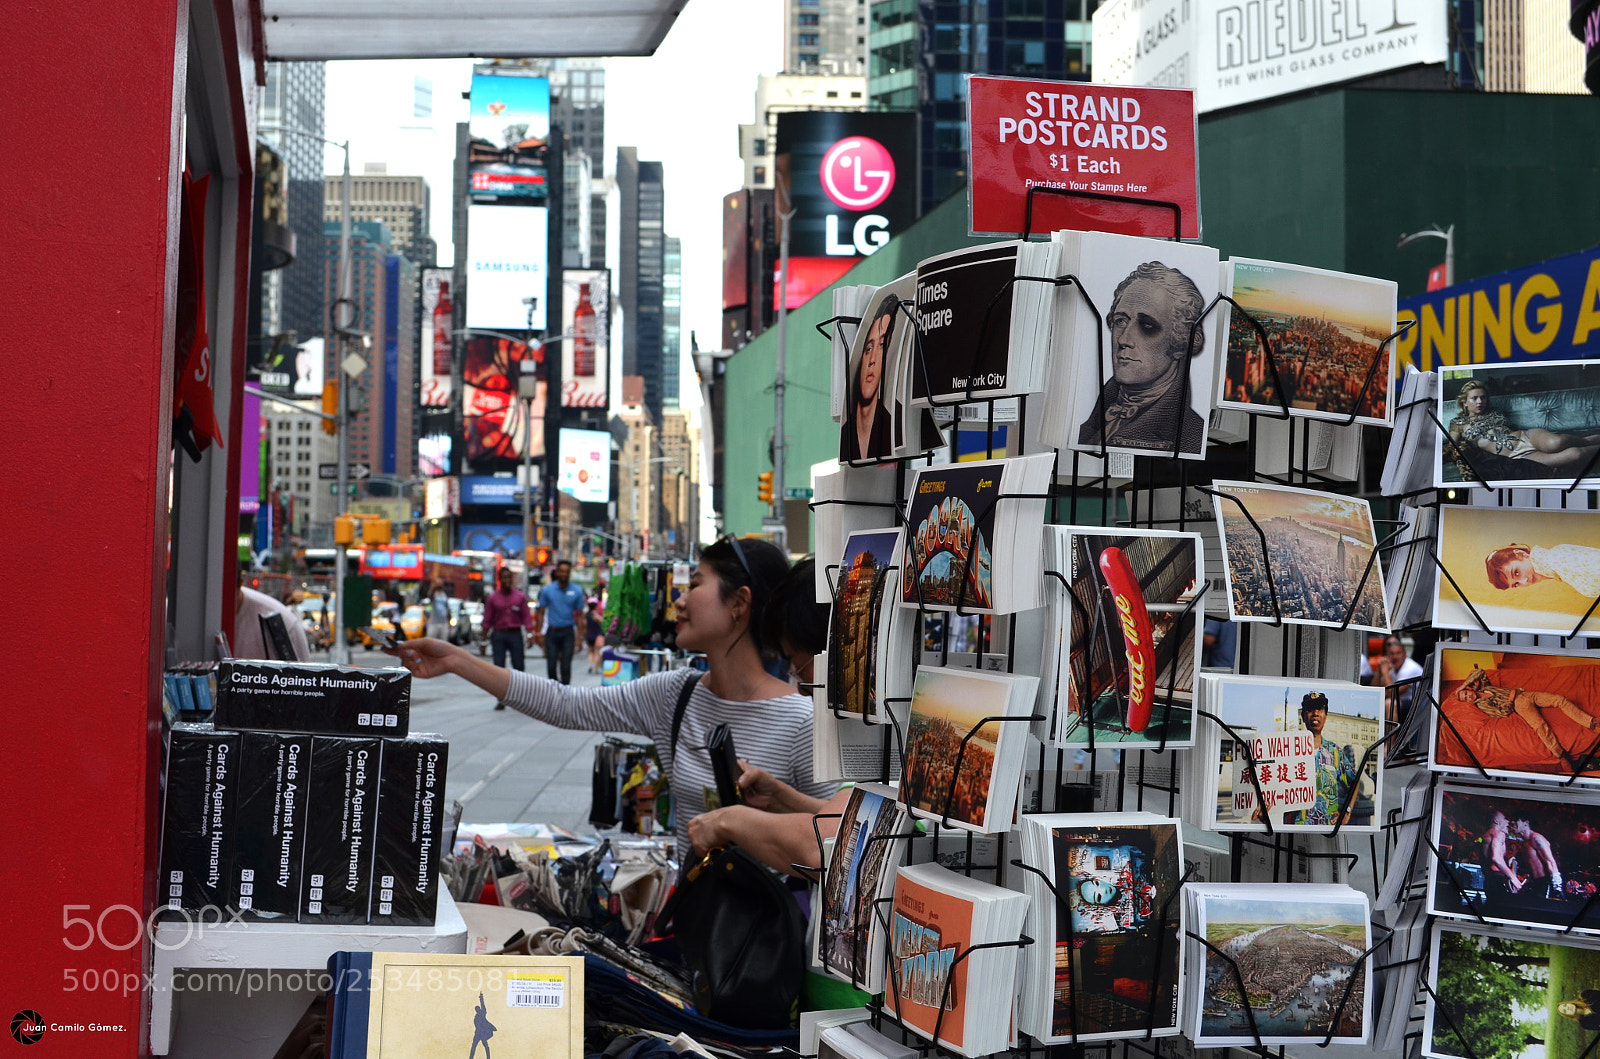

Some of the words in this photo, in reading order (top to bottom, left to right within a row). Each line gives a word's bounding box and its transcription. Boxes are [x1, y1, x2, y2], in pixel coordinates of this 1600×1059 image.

[1216, 0, 1367, 71] RIEDEL
[1217, 74, 1241, 89] THE
[1247, 66, 1282, 82] WINE
[1289, 54, 1335, 73] GLASS
[1342, 34, 1418, 61] COMPANY
[1026, 91, 1141, 122] STRAND
[999, 117, 1167, 151] POSTCARDS
[1050, 153, 1069, 172] $1
[1078, 155, 1120, 174] Each
[1025, 178, 1066, 190] Purchase
[1069, 180, 1088, 190] Your
[1091, 181, 1124, 192] Stamps
[1126, 182, 1147, 193] Here
[826, 214, 890, 256] LG
[475, 262, 539, 272] SAMSUNG
[918, 281, 948, 305] Times
[916, 308, 952, 335] Square
[952, 377, 967, 389] New
[968, 375, 985, 387] ork
[987, 373, 1005, 387] City
[977, 479, 993, 493] from
[1115, 593, 1142, 647] me
[231, 672, 268, 685] Cards
[271, 674, 317, 688] Against
[320, 677, 377, 692] Humanity
[1126, 649, 1146, 706] eat
[216, 744, 229, 780] Cards
[287, 744, 300, 780] Cards
[1268, 737, 1290, 758] WAH
[1294, 735, 1313, 756] BUS
[355, 750, 368, 786] Cards
[426, 752, 438, 788] Cards
[212, 783, 226, 828] Against
[284, 783, 297, 828] Against
[343, 798, 351, 820] horrible
[352, 788, 366, 833] Against
[422, 790, 436, 835] Against
[1235, 791, 1253, 810] NEW
[1284, 787, 1314, 805] BOSTON
[206, 831, 222, 888] Humanity
[277, 830, 294, 887] Humanity
[346, 836, 362, 893] Humanity
[416, 837, 432, 894] Humanity
